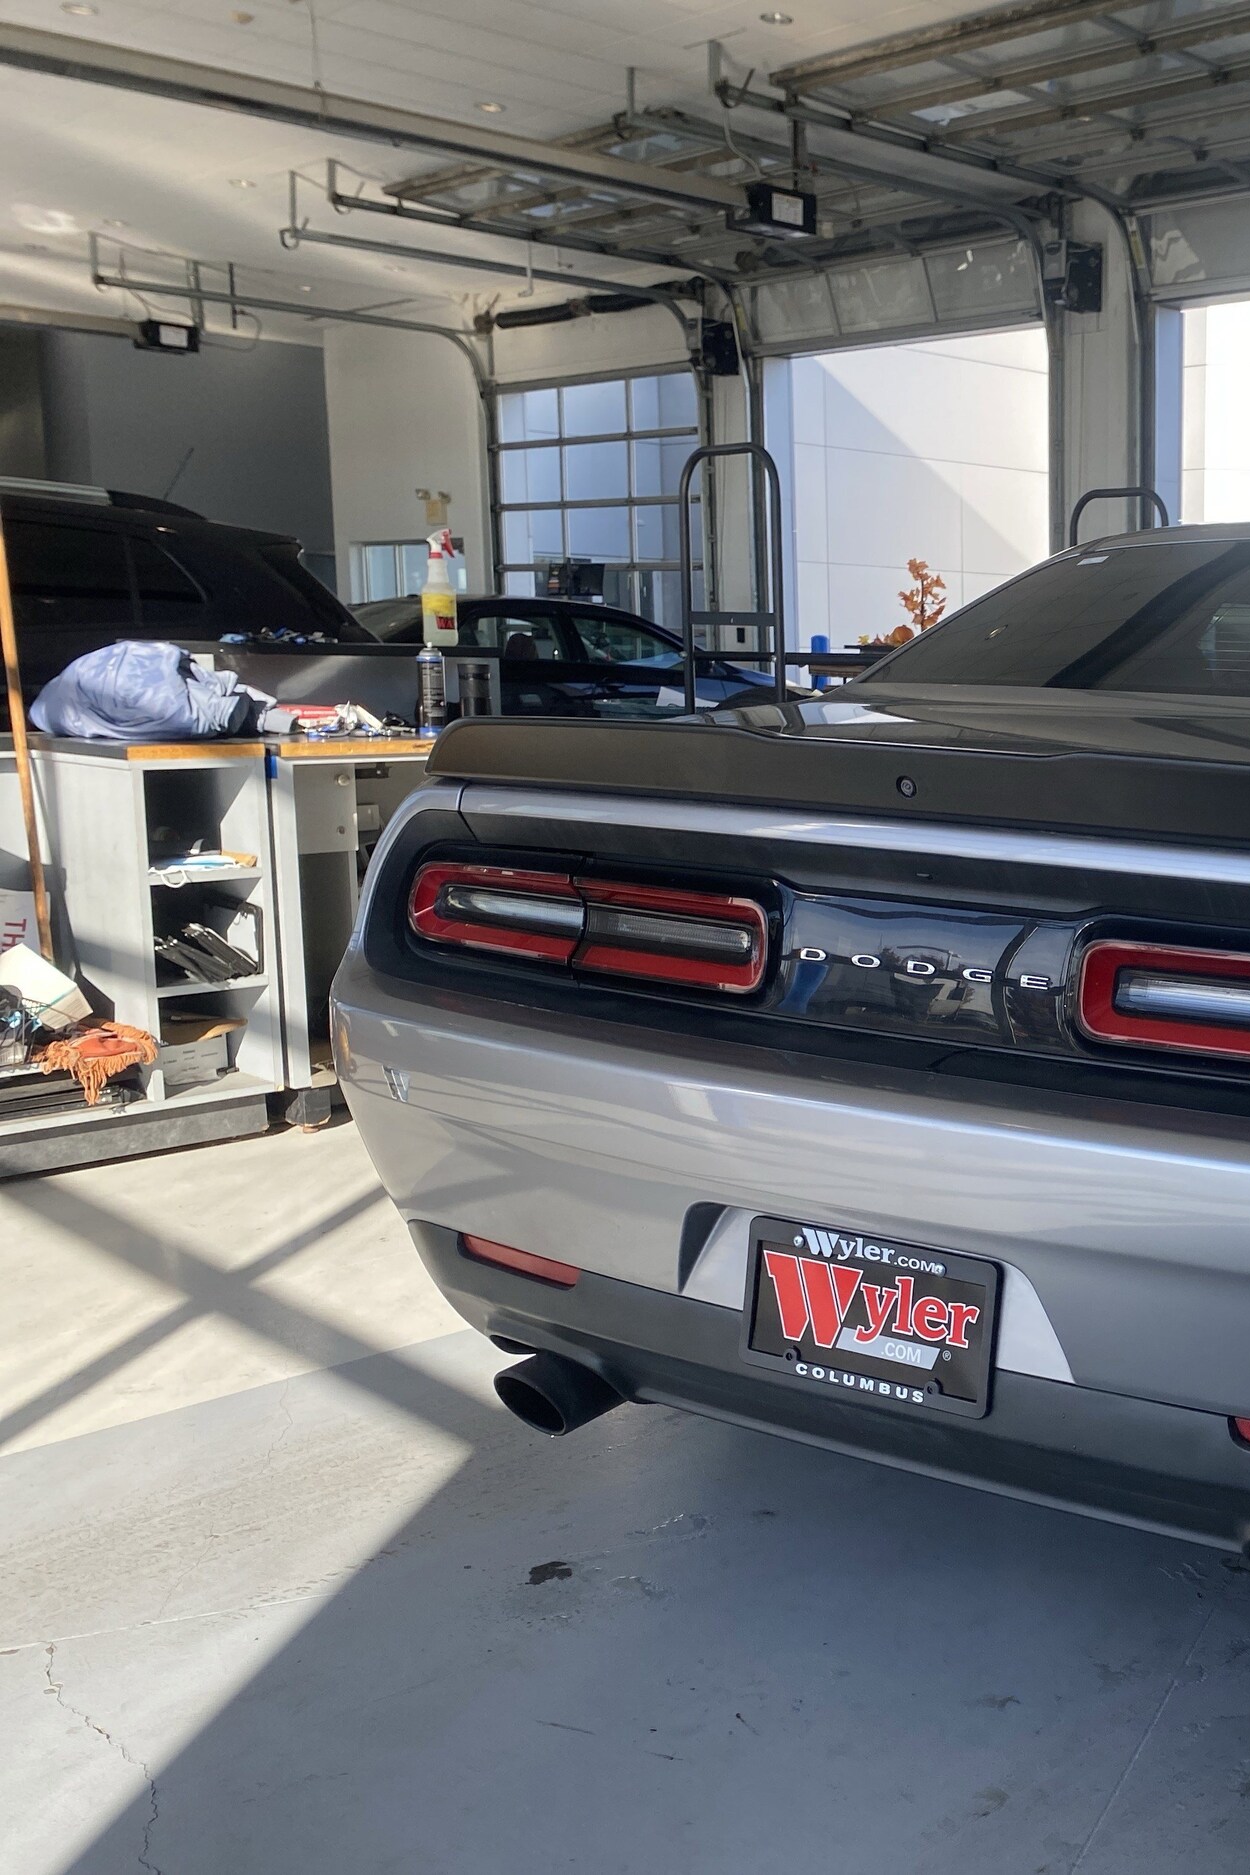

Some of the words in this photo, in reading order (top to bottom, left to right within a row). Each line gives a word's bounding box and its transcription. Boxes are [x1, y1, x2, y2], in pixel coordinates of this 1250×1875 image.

[800, 947, 1050, 990] DODGE
[764, 1250, 980, 1349] Wyler
[881, 1342, 921, 1363] .COM
[796, 1363, 924, 1403] COLUMBUS
